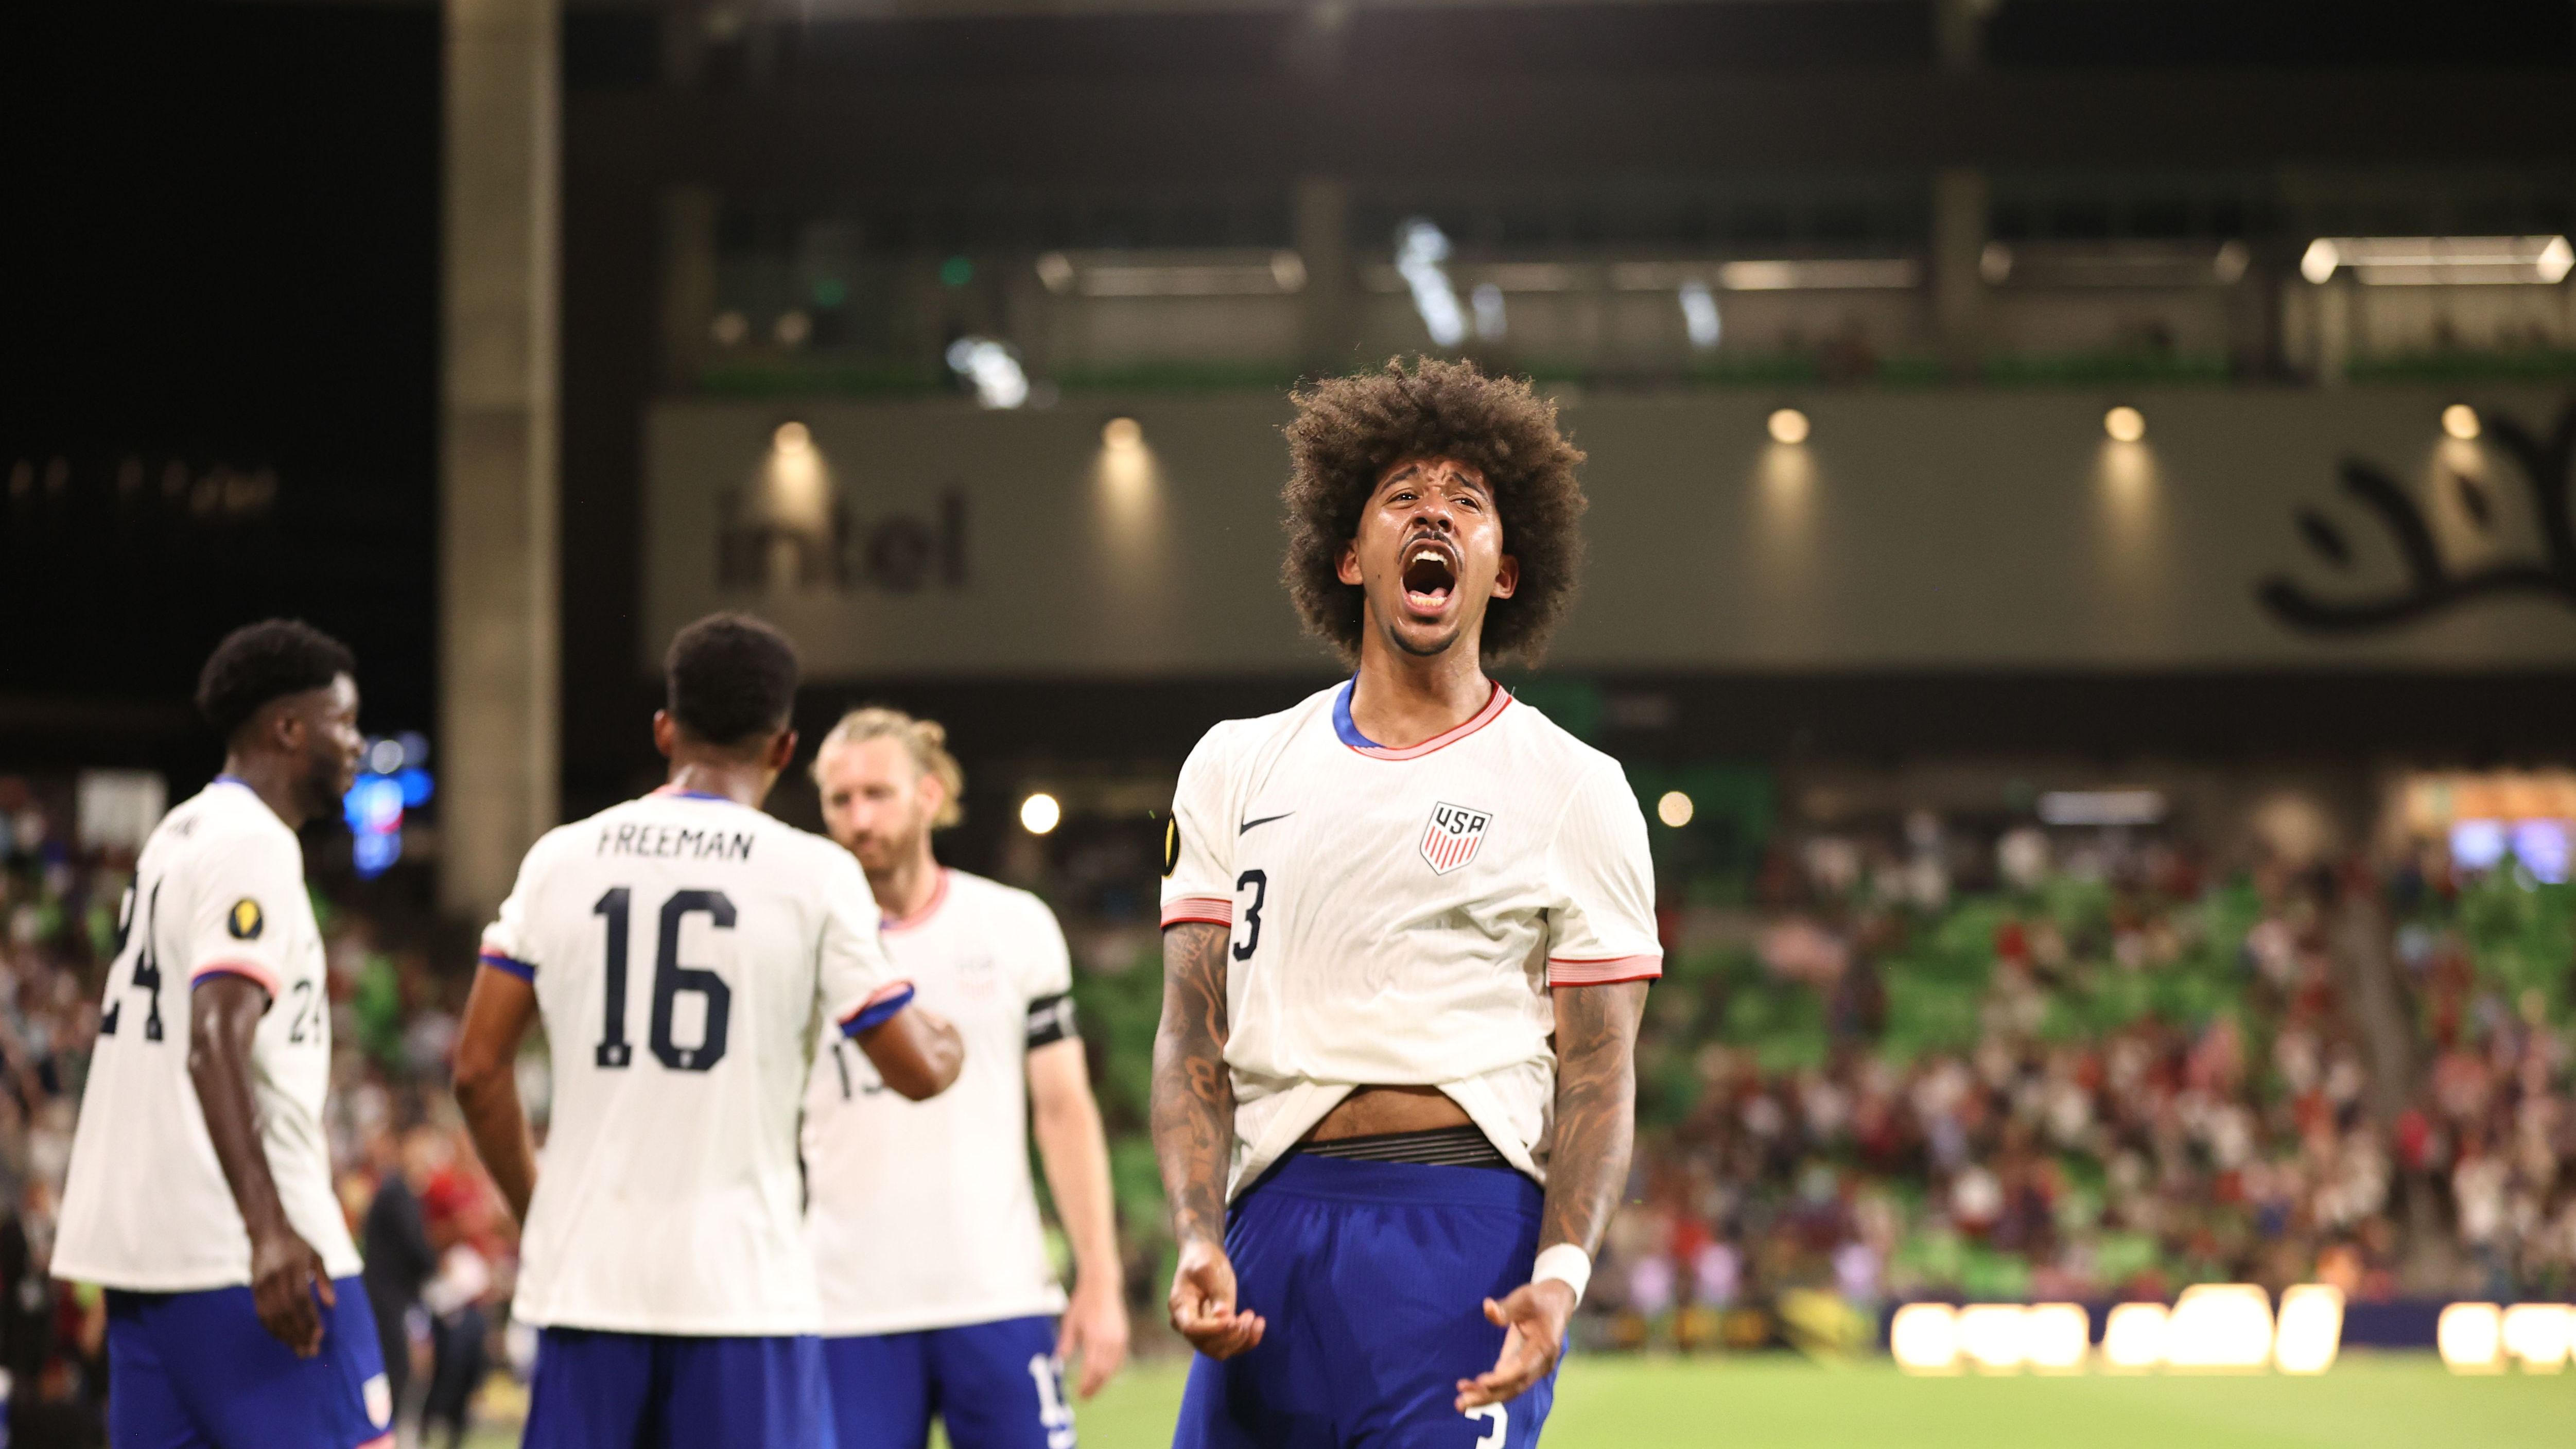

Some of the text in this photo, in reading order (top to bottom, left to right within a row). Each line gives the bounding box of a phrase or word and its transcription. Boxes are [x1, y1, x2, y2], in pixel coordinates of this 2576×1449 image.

[597, 824, 755, 861] FREEMAN
[1436, 807, 1486, 834] USA
[1233, 869, 1267, 962] 3
[594, 887, 737, 1071] 16
